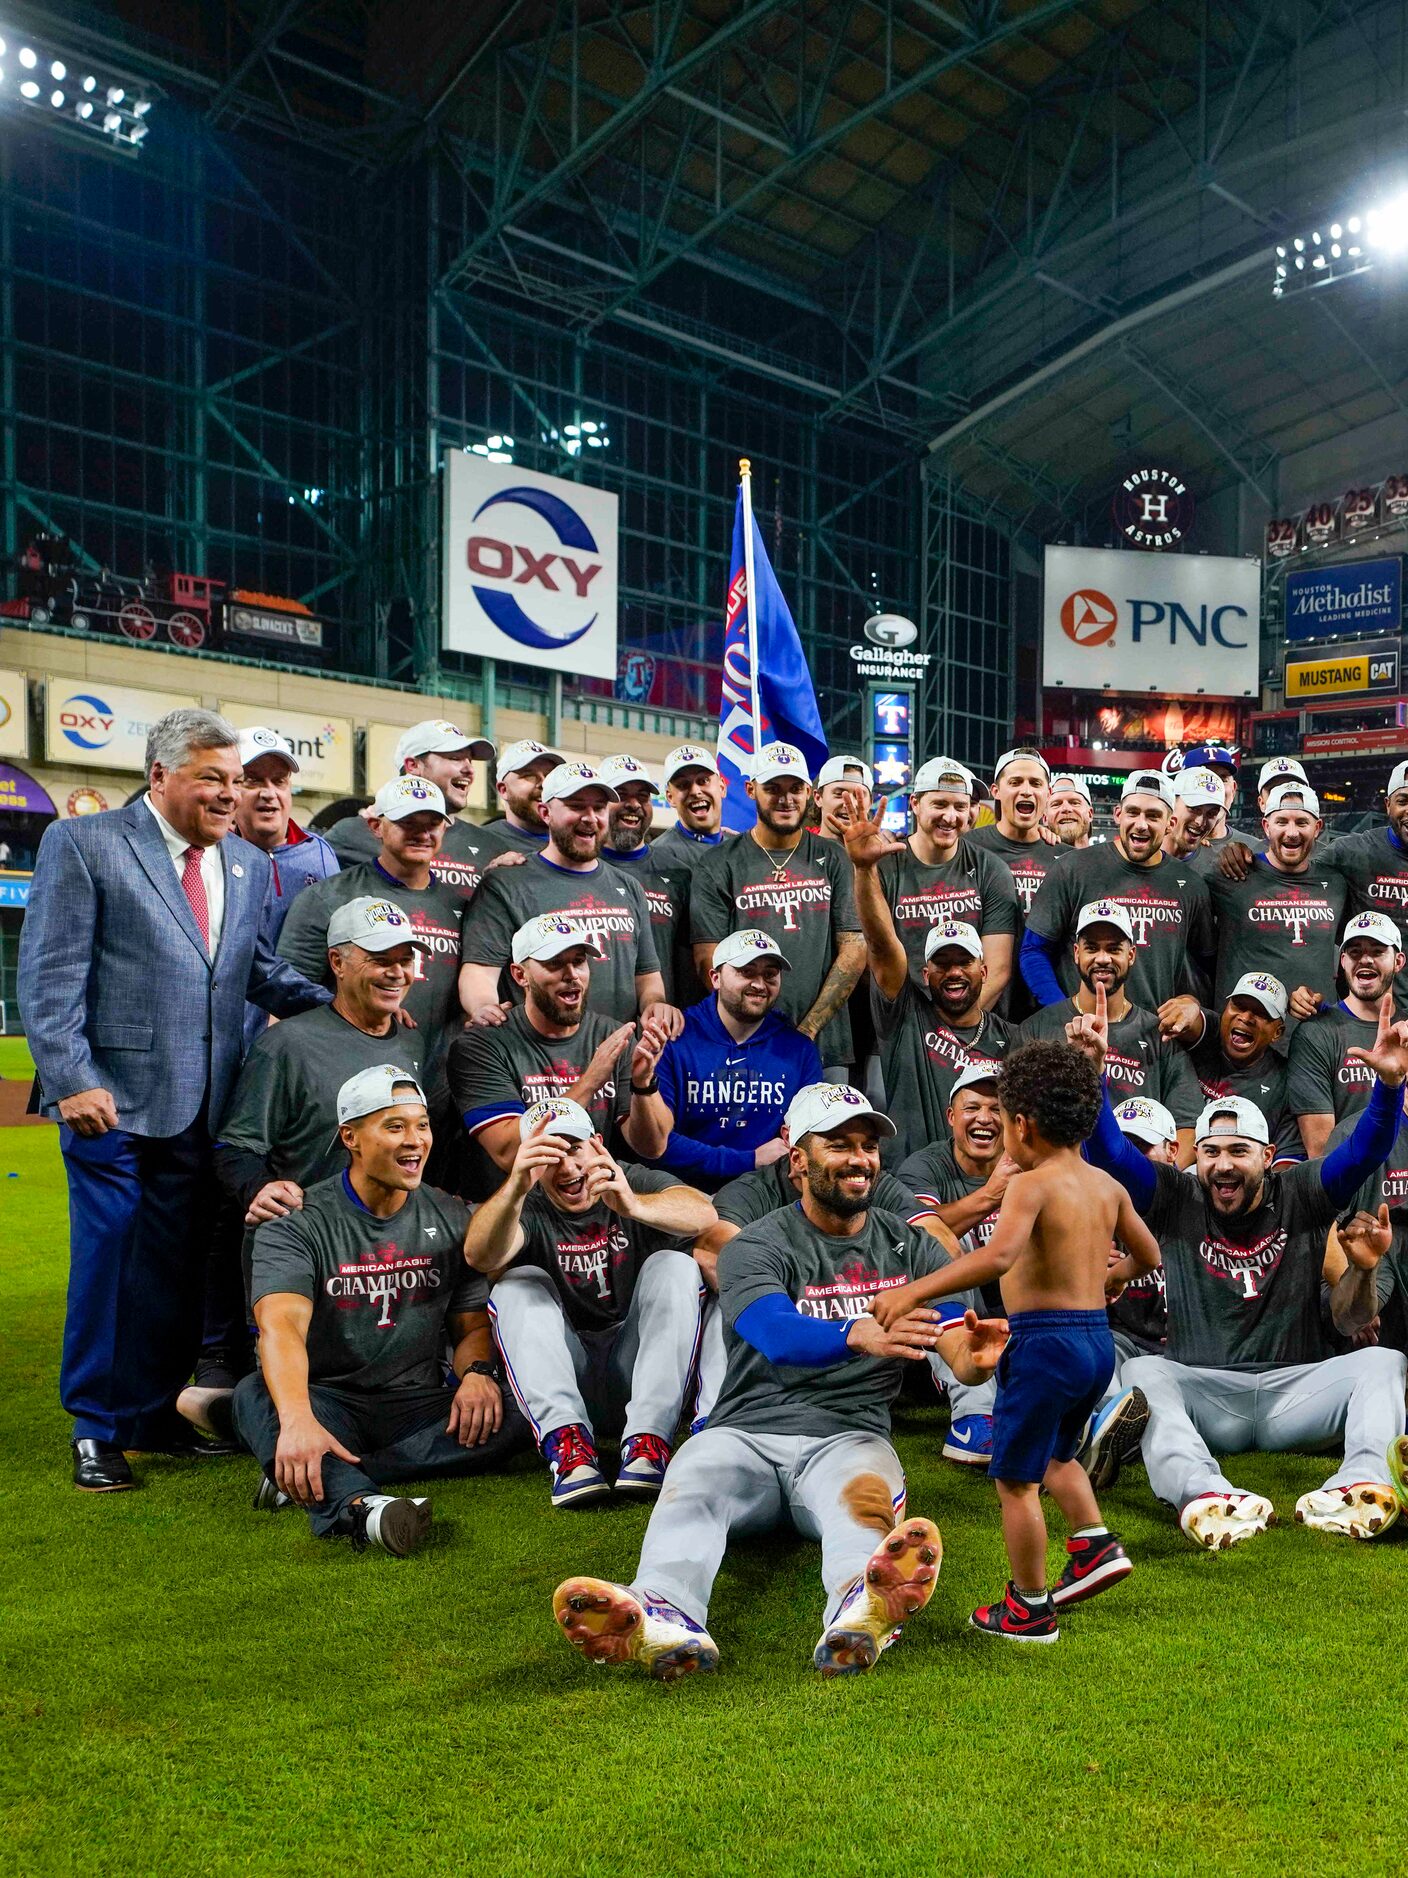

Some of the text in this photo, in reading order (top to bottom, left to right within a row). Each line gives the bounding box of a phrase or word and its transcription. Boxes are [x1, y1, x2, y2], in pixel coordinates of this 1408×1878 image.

[1123, 468, 1187, 496] HOUSTON
[1140, 493, 1169, 523] H
[1306, 502, 1332, 528] 40
[1124, 524, 1183, 547] ASTROS
[1268, 517, 1292, 542] 32
[467, 536, 603, 598] OXY
[1291, 583, 1333, 596] HOUSTON
[1292, 583, 1392, 616] Methodist
[1125, 599, 1249, 649] PNC
[1318, 606, 1393, 623] LEADING MEDICINE
[849, 645, 932, 667] Gallagher
[856, 664, 924, 680] INSURANCE
[1299, 660, 1395, 687] MUSTANG CAT
[59, 711, 115, 732] OXY
[877, 705, 907, 734] T
[1306, 739, 1330, 748] MISSION
[1330, 737, 1360, 746] CONTROL
[1203, 747, 1218, 760] T
[439, 860, 475, 872] LEAGUE
[744, 878, 825, 893] AMERICAN LEAGUE
[735, 885, 832, 910] CHAMPIONS
[901, 889, 976, 904] AMERICAN LEAGUE
[1106, 897, 1179, 907] AMERICAN LEAGUE
[1255, 899, 1328, 907] AMERICAN LEAGUE
[596, 908, 629, 916] LEAGUE
[774, 899, 801, 931] T
[895, 896, 982, 920] CHAMPIONS
[1121, 905, 1182, 924] AMPIONS
[1247, 906, 1335, 923] CHAMPIONS
[423, 926, 460, 939] LEAGUE
[569, 915, 635, 933] AMPIONS
[1105, 1054, 1141, 1068] LEAGUE
[687, 1071, 787, 1080] TEXAS
[687, 1079, 786, 1106] RANGERS
[1200, 1232, 1288, 1274] CHAMPIONS
[326, 1267, 441, 1297] CHAMPIONS
[807, 1276, 907, 1297] AMERICAN LEAGUE
[1230, 1265, 1265, 1300] T
[369, 1286, 398, 1327] T
